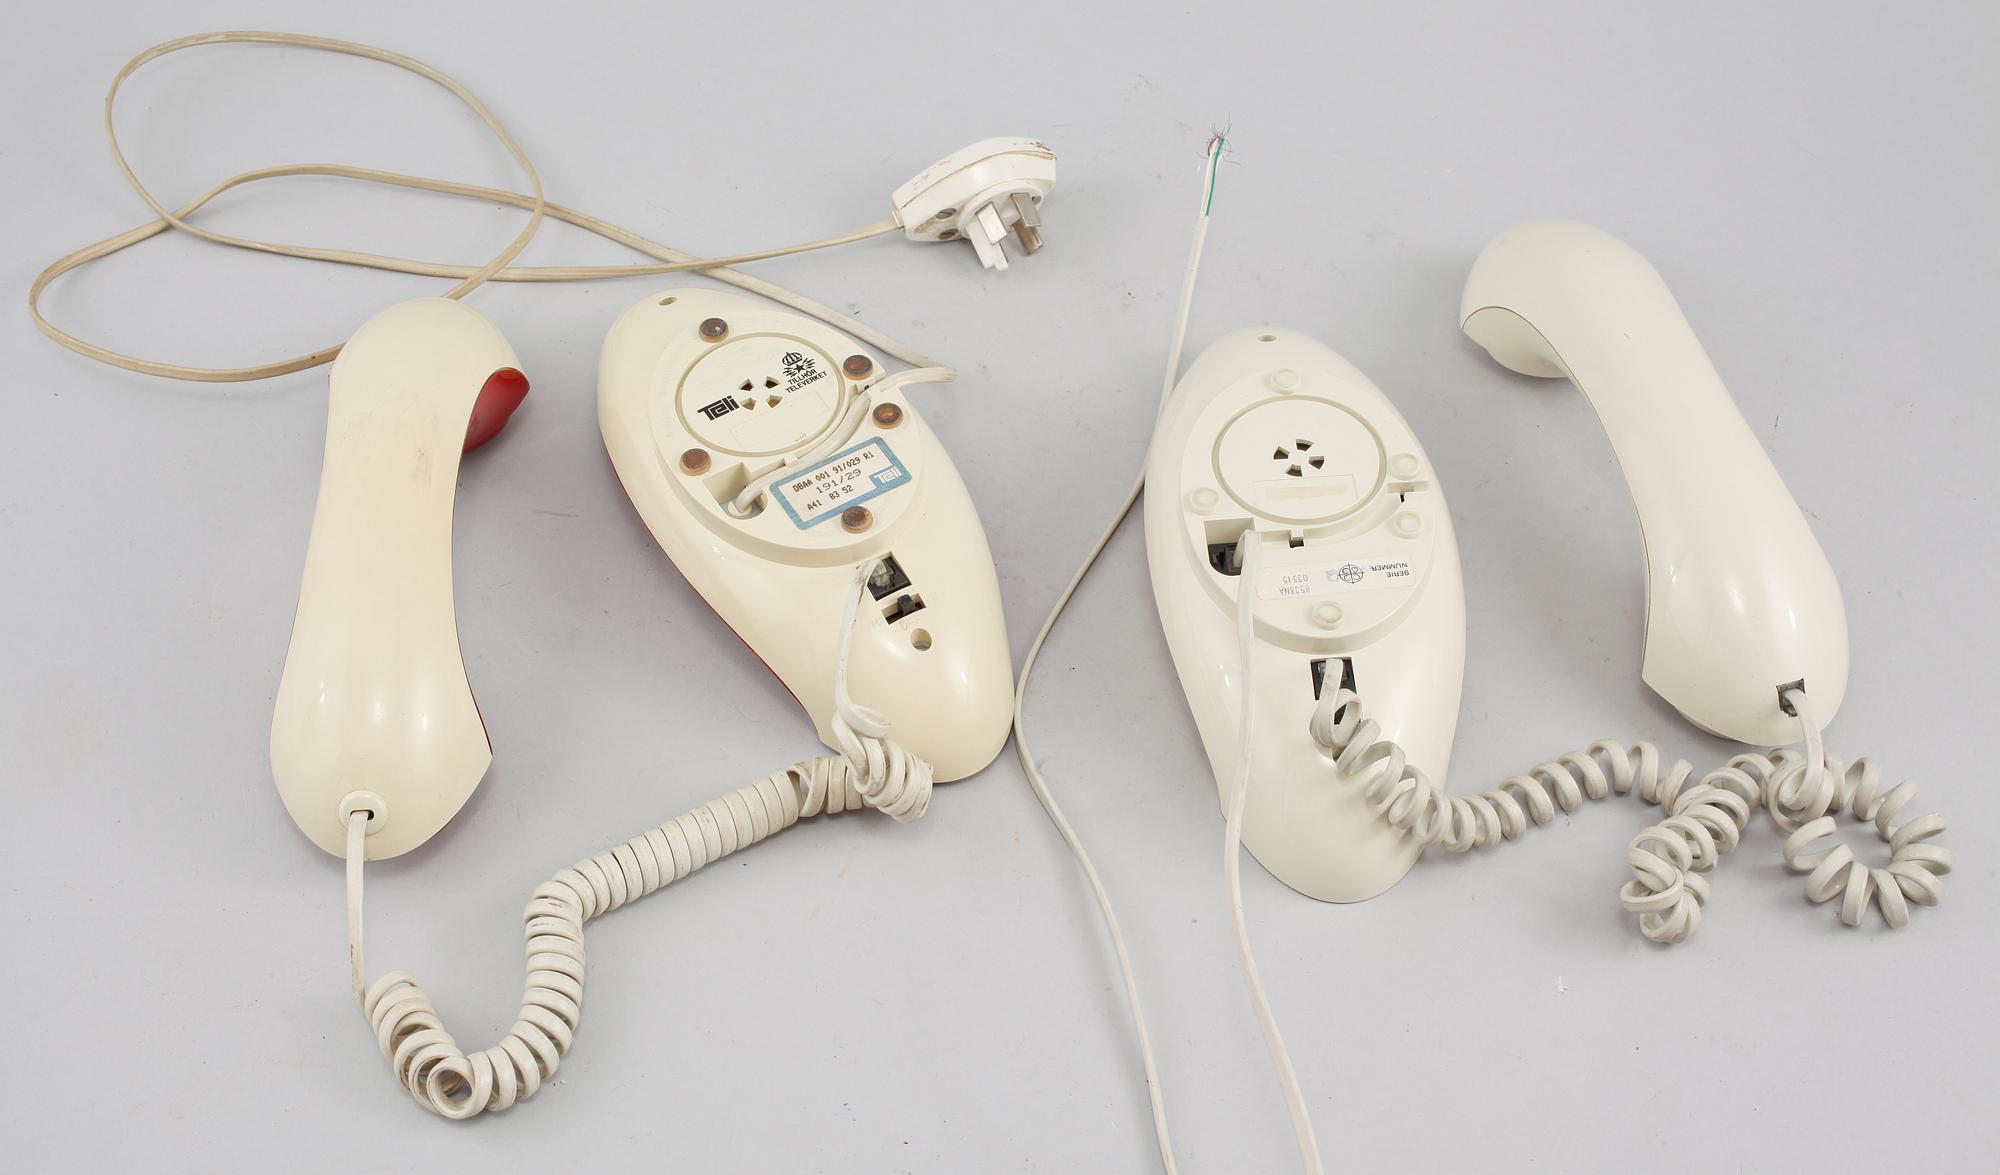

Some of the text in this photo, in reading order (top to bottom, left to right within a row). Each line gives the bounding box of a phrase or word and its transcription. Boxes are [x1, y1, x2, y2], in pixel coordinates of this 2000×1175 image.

[785, 370, 827, 393] TELEVERKET
[787, 368, 817, 385] TILLHÖR
[696, 395, 740, 421] Teli
[792, 450, 875, 493] DBAA 001 91/029 R1
[816, 468, 862, 494] 191/29
[807, 499, 823, 511] A41
[841, 484, 854, 494] 52
[1385, 569, 1410, 579] SERIE
